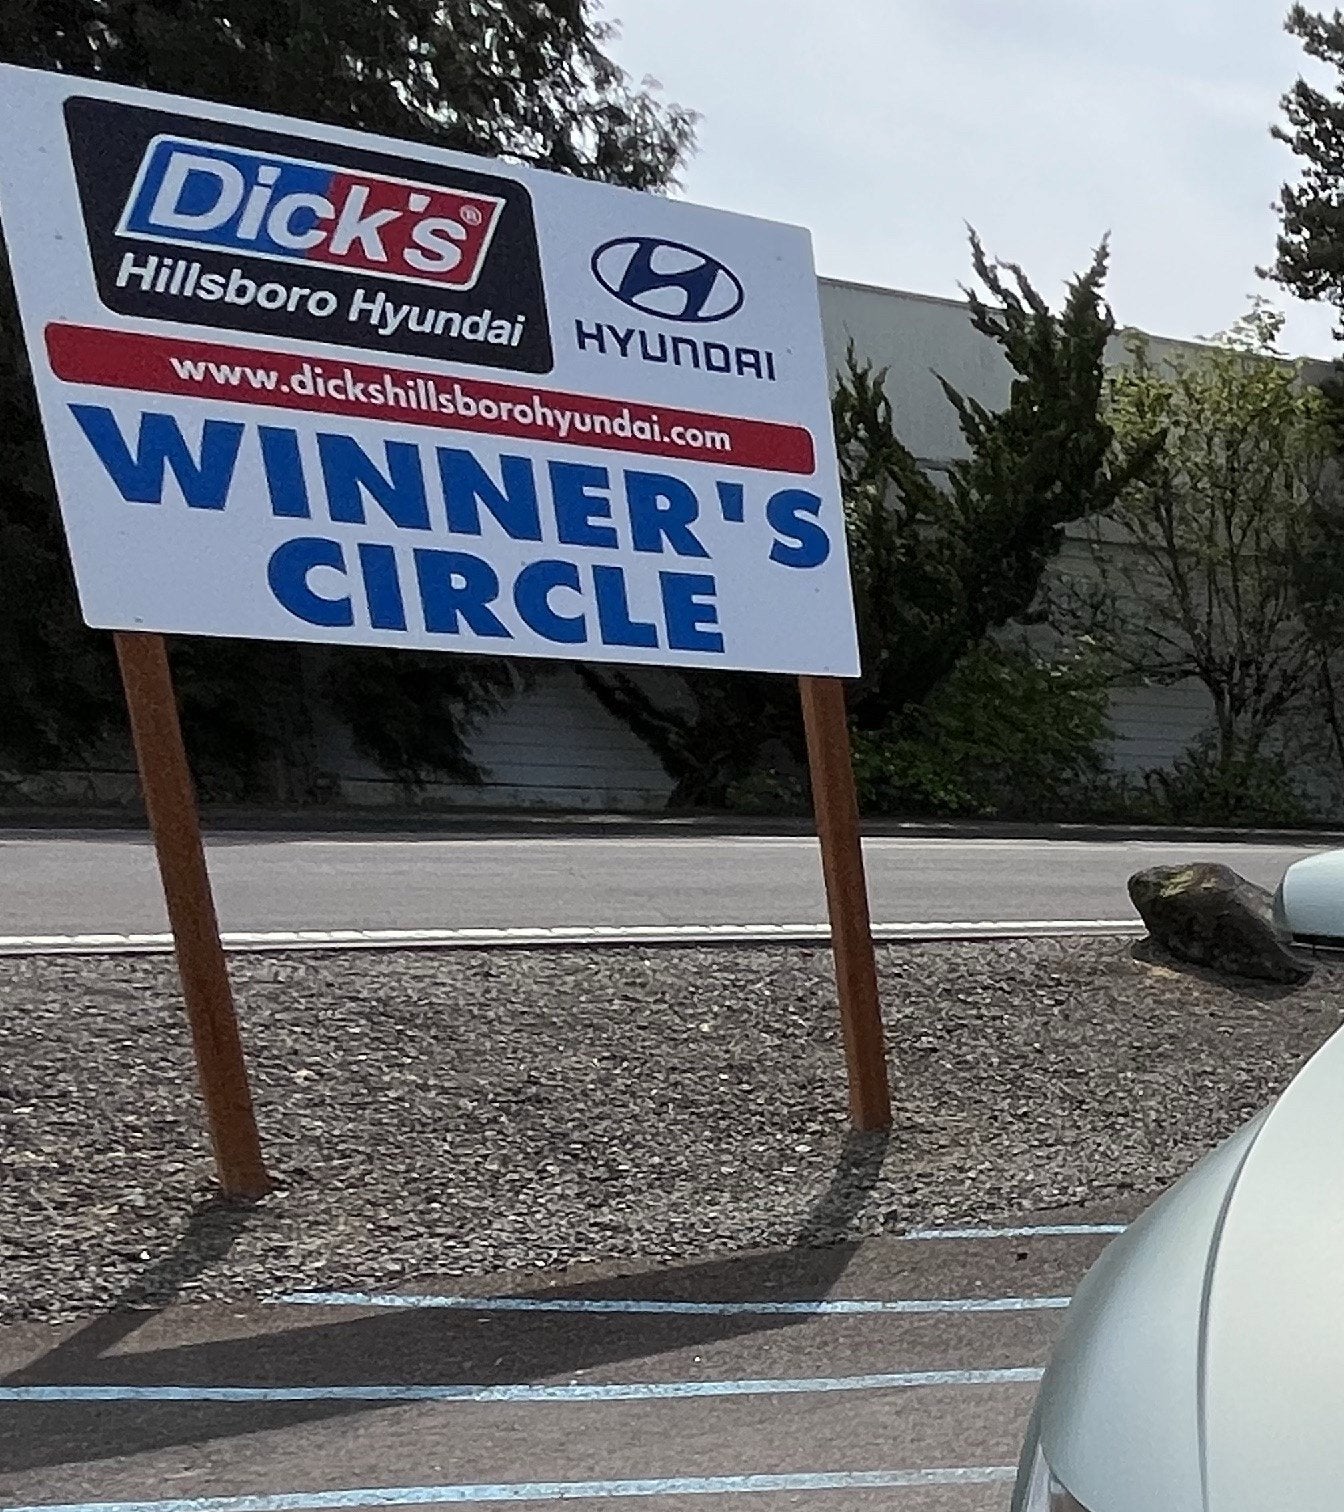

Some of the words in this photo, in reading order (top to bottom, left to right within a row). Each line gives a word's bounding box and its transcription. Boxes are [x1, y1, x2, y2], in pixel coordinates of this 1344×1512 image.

[149, 151, 467, 273] Dick's
[115, 252, 338, 317] Hillsboro
[348, 289, 526, 347] Hyundai
[574, 319, 777, 383] HYUNDAI
[170, 353, 732, 453] www.dickshillsborohyundai.com
[68, 403, 832, 570] WINNER'S
[267, 536, 726, 655] CIRCLE
